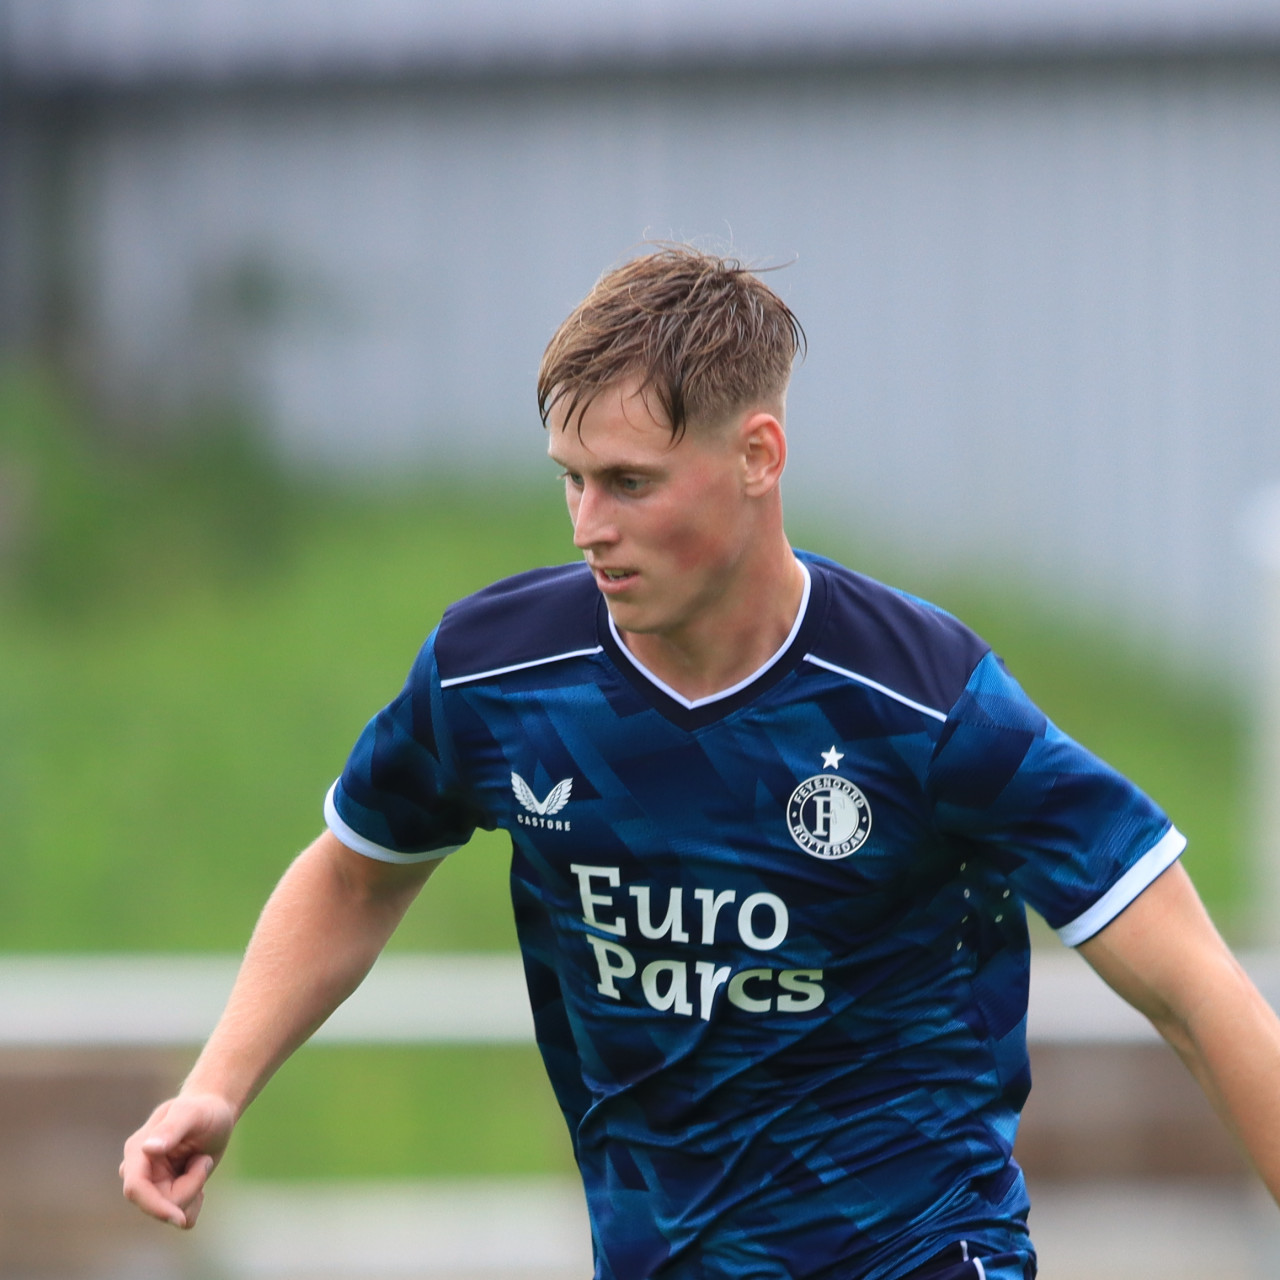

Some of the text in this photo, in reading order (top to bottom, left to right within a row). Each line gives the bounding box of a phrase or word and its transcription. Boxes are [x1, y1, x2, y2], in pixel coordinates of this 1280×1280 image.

[793, 777, 865, 809] FEYENOORD
[517, 814, 571, 832] CASTORE
[793, 824, 866, 856] ROTTERDAM
[570, 863, 789, 951] Euro
[586, 934, 826, 1022] Parcs
